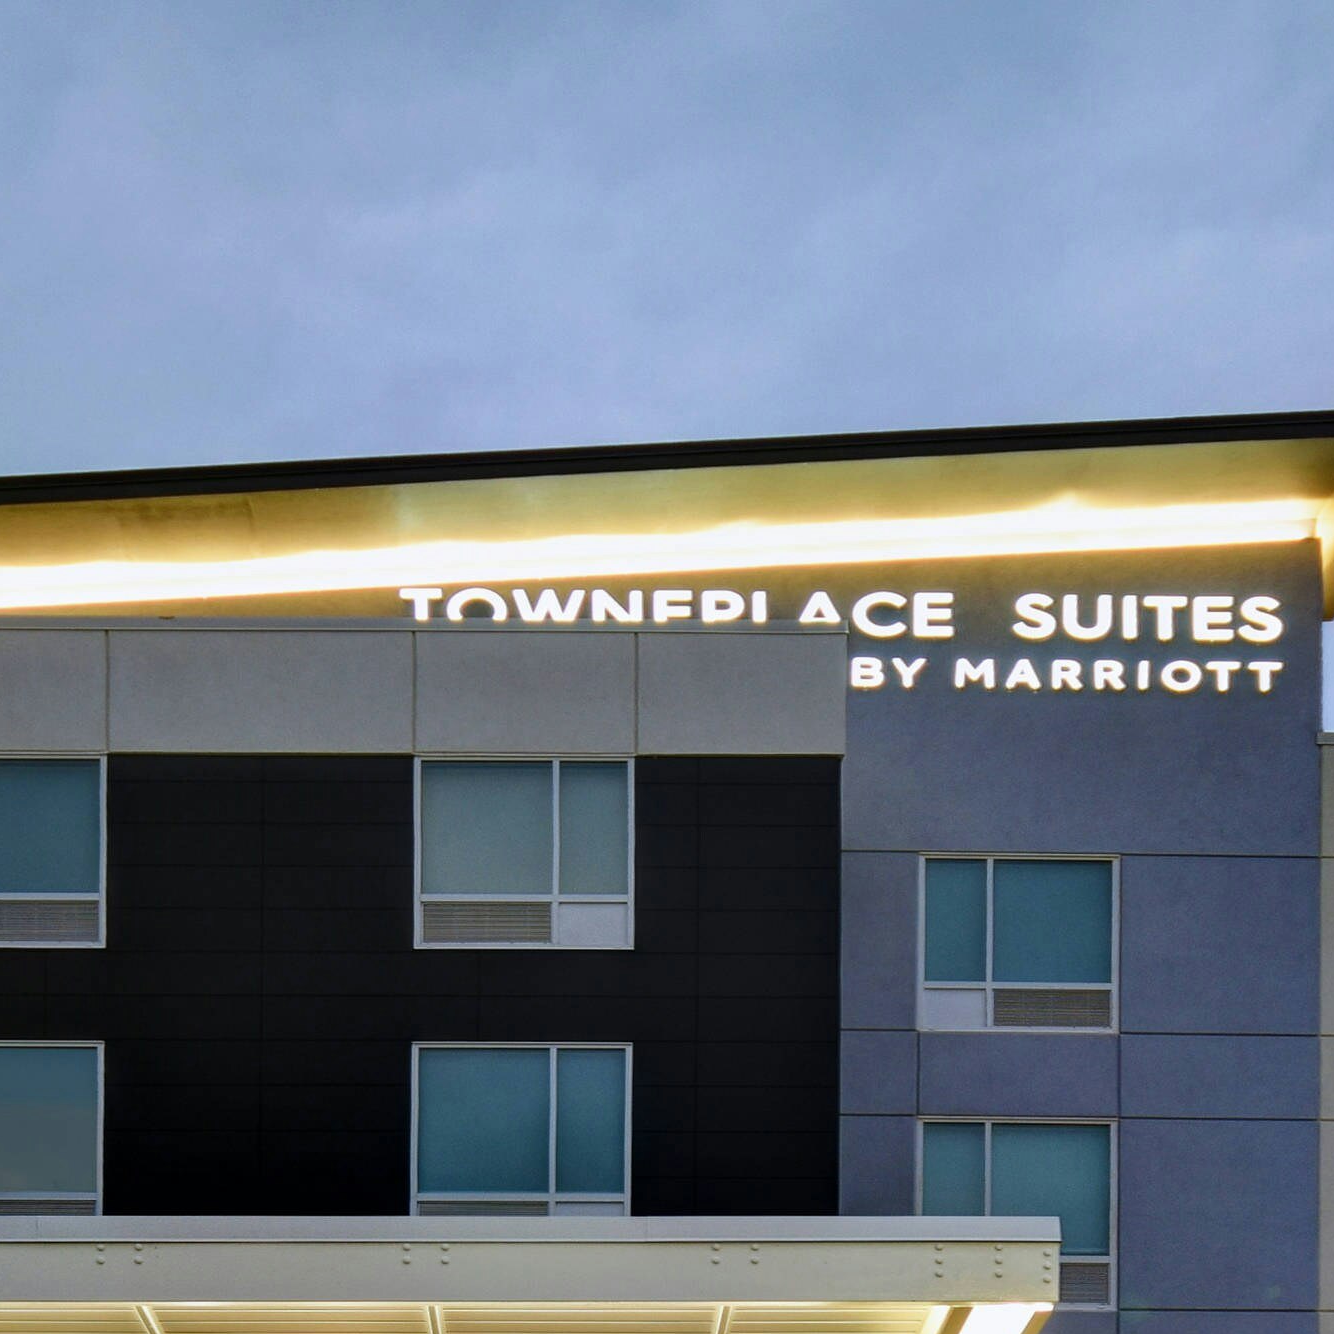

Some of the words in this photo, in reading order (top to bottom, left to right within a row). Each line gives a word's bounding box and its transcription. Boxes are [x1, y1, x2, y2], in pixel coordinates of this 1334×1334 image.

[1012, 592, 1284, 643] SUITES
[850, 656, 927, 690] BY
[954, 657, 1284, 694] MARRIOTT
